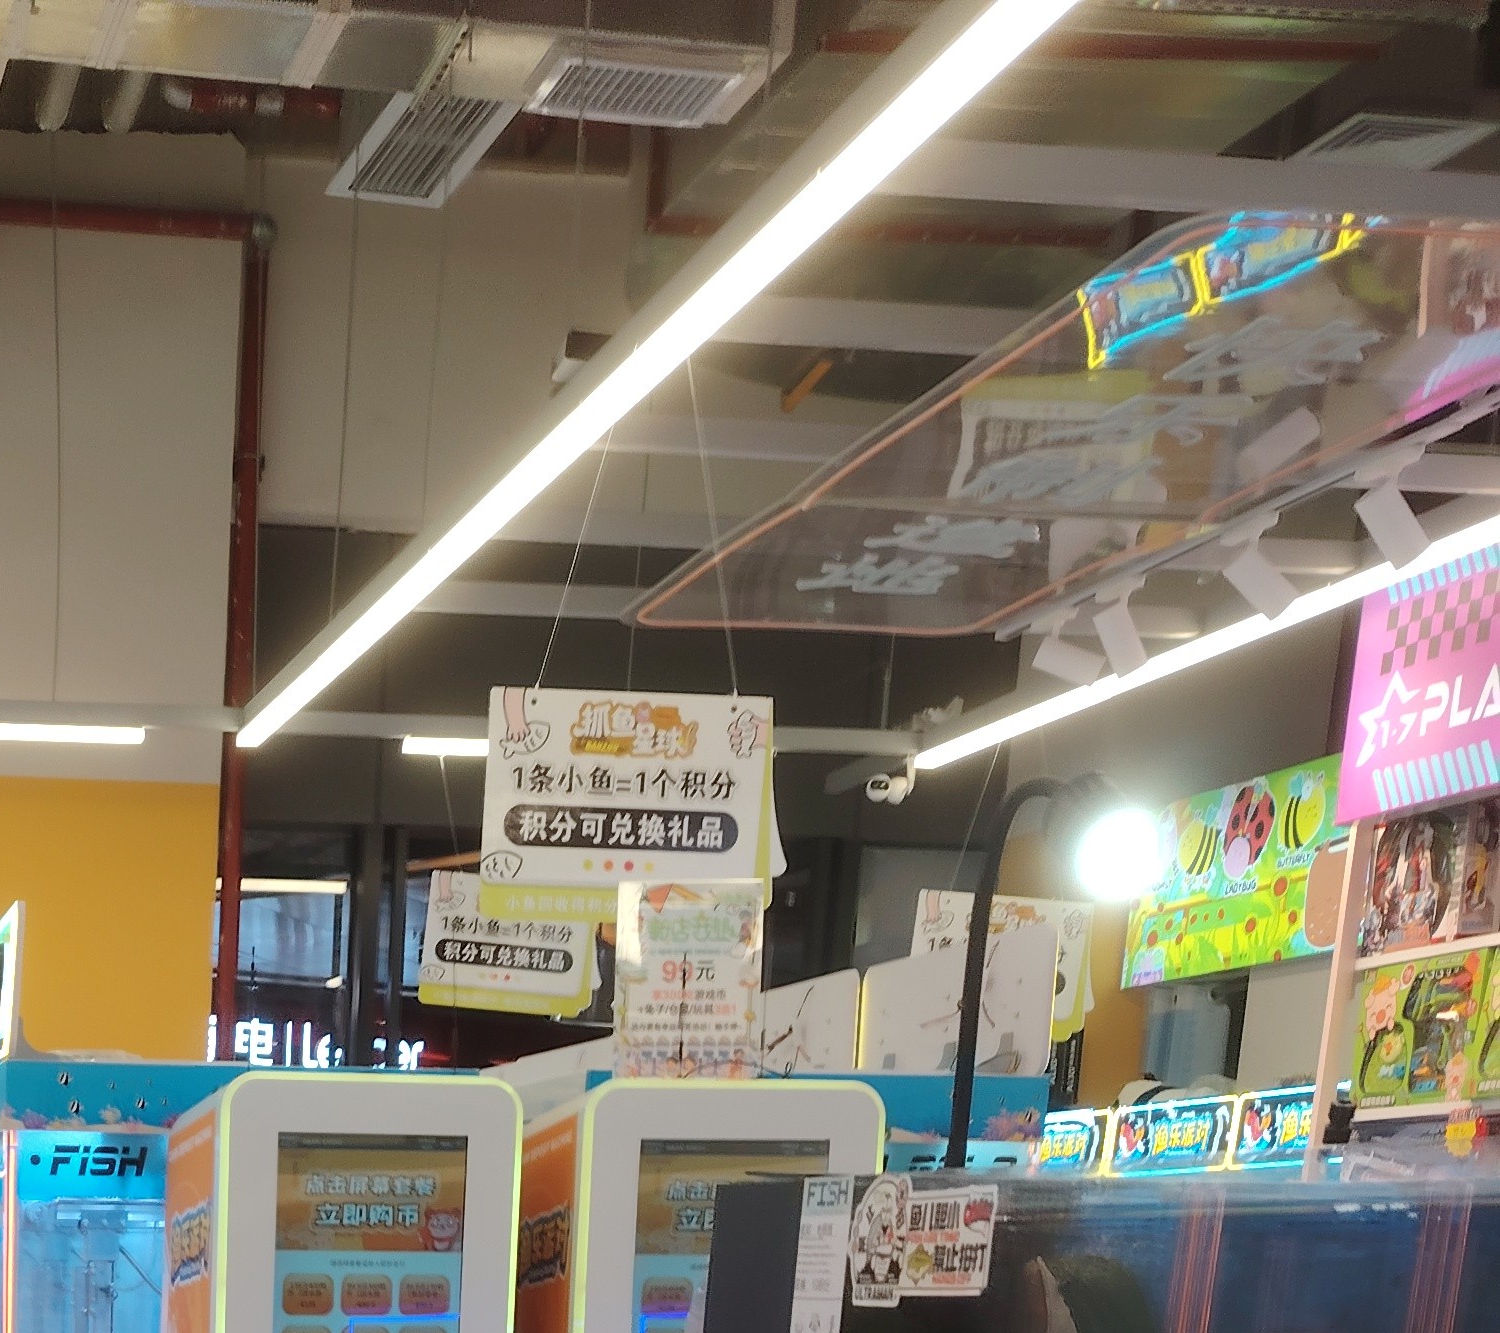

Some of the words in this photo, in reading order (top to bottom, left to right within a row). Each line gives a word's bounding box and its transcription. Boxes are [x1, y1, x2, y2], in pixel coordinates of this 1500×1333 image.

[512, 763, 736, 801] 1条小鱼=1个积分
[519, 809, 724, 849] 积分可兑换礼品
[440, 915, 574, 944] 1条小鱼=1个积分
[443, 941, 566, 971] 积分可兑换礼品
[1153, 1113, 1212, 1153] 渔乐派对
[315, 1201, 420, 1228] 立即购币
